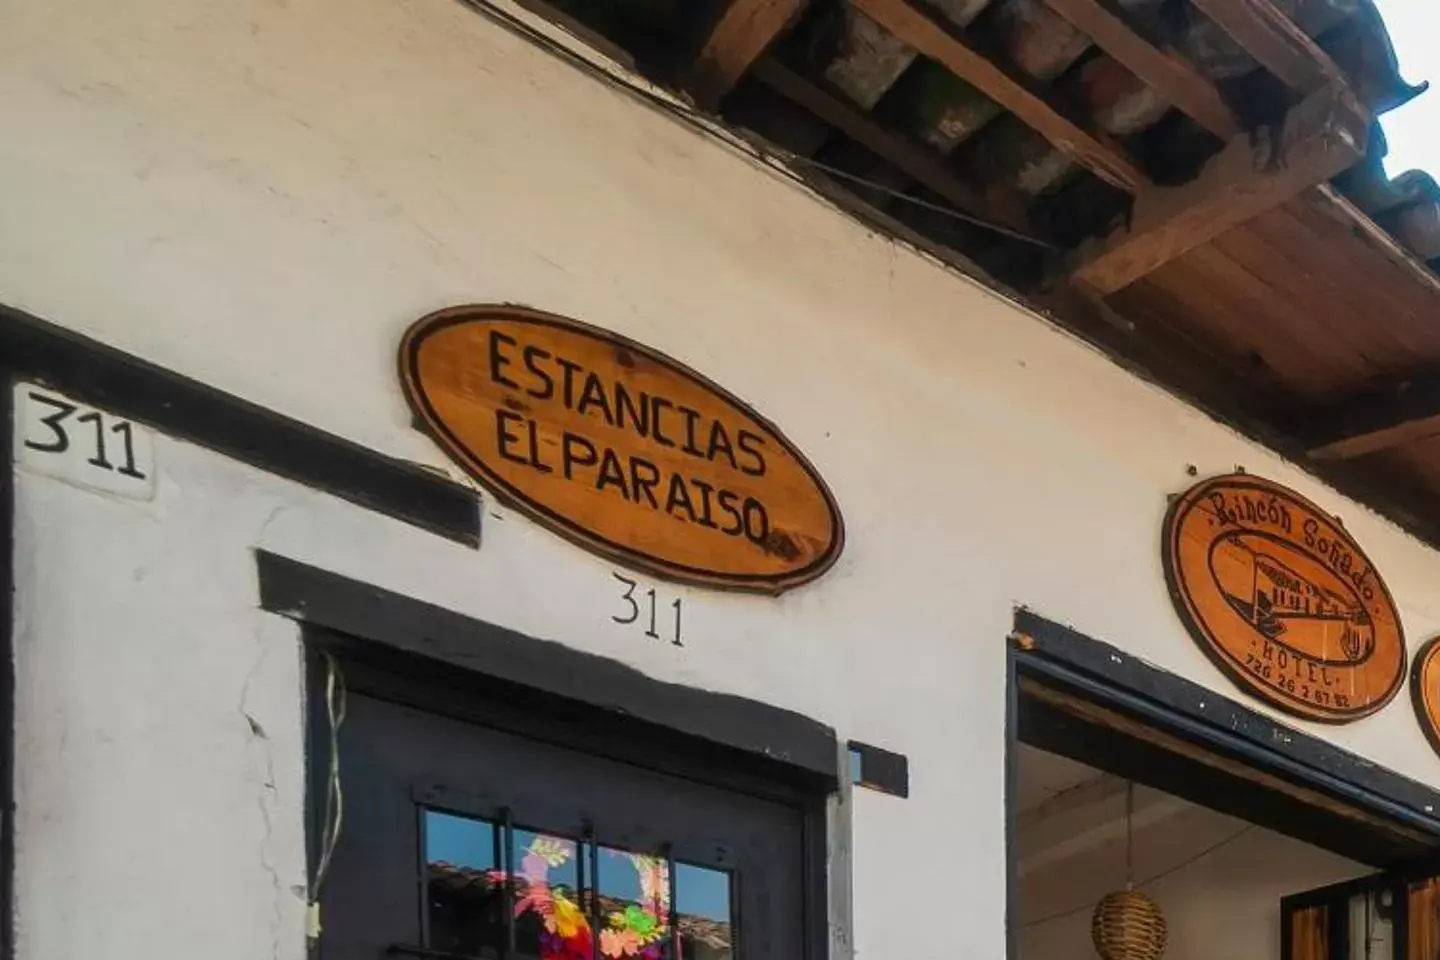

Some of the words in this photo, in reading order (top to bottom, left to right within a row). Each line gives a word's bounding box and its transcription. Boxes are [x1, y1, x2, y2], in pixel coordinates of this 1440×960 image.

[24, 391, 147, 480] 311
[489, 329, 767, 477] ESTANCIAS
[496, 407, 553, 474] EL
[562, 431, 769, 546] PARAISO
[611, 571, 685, 648] 311
